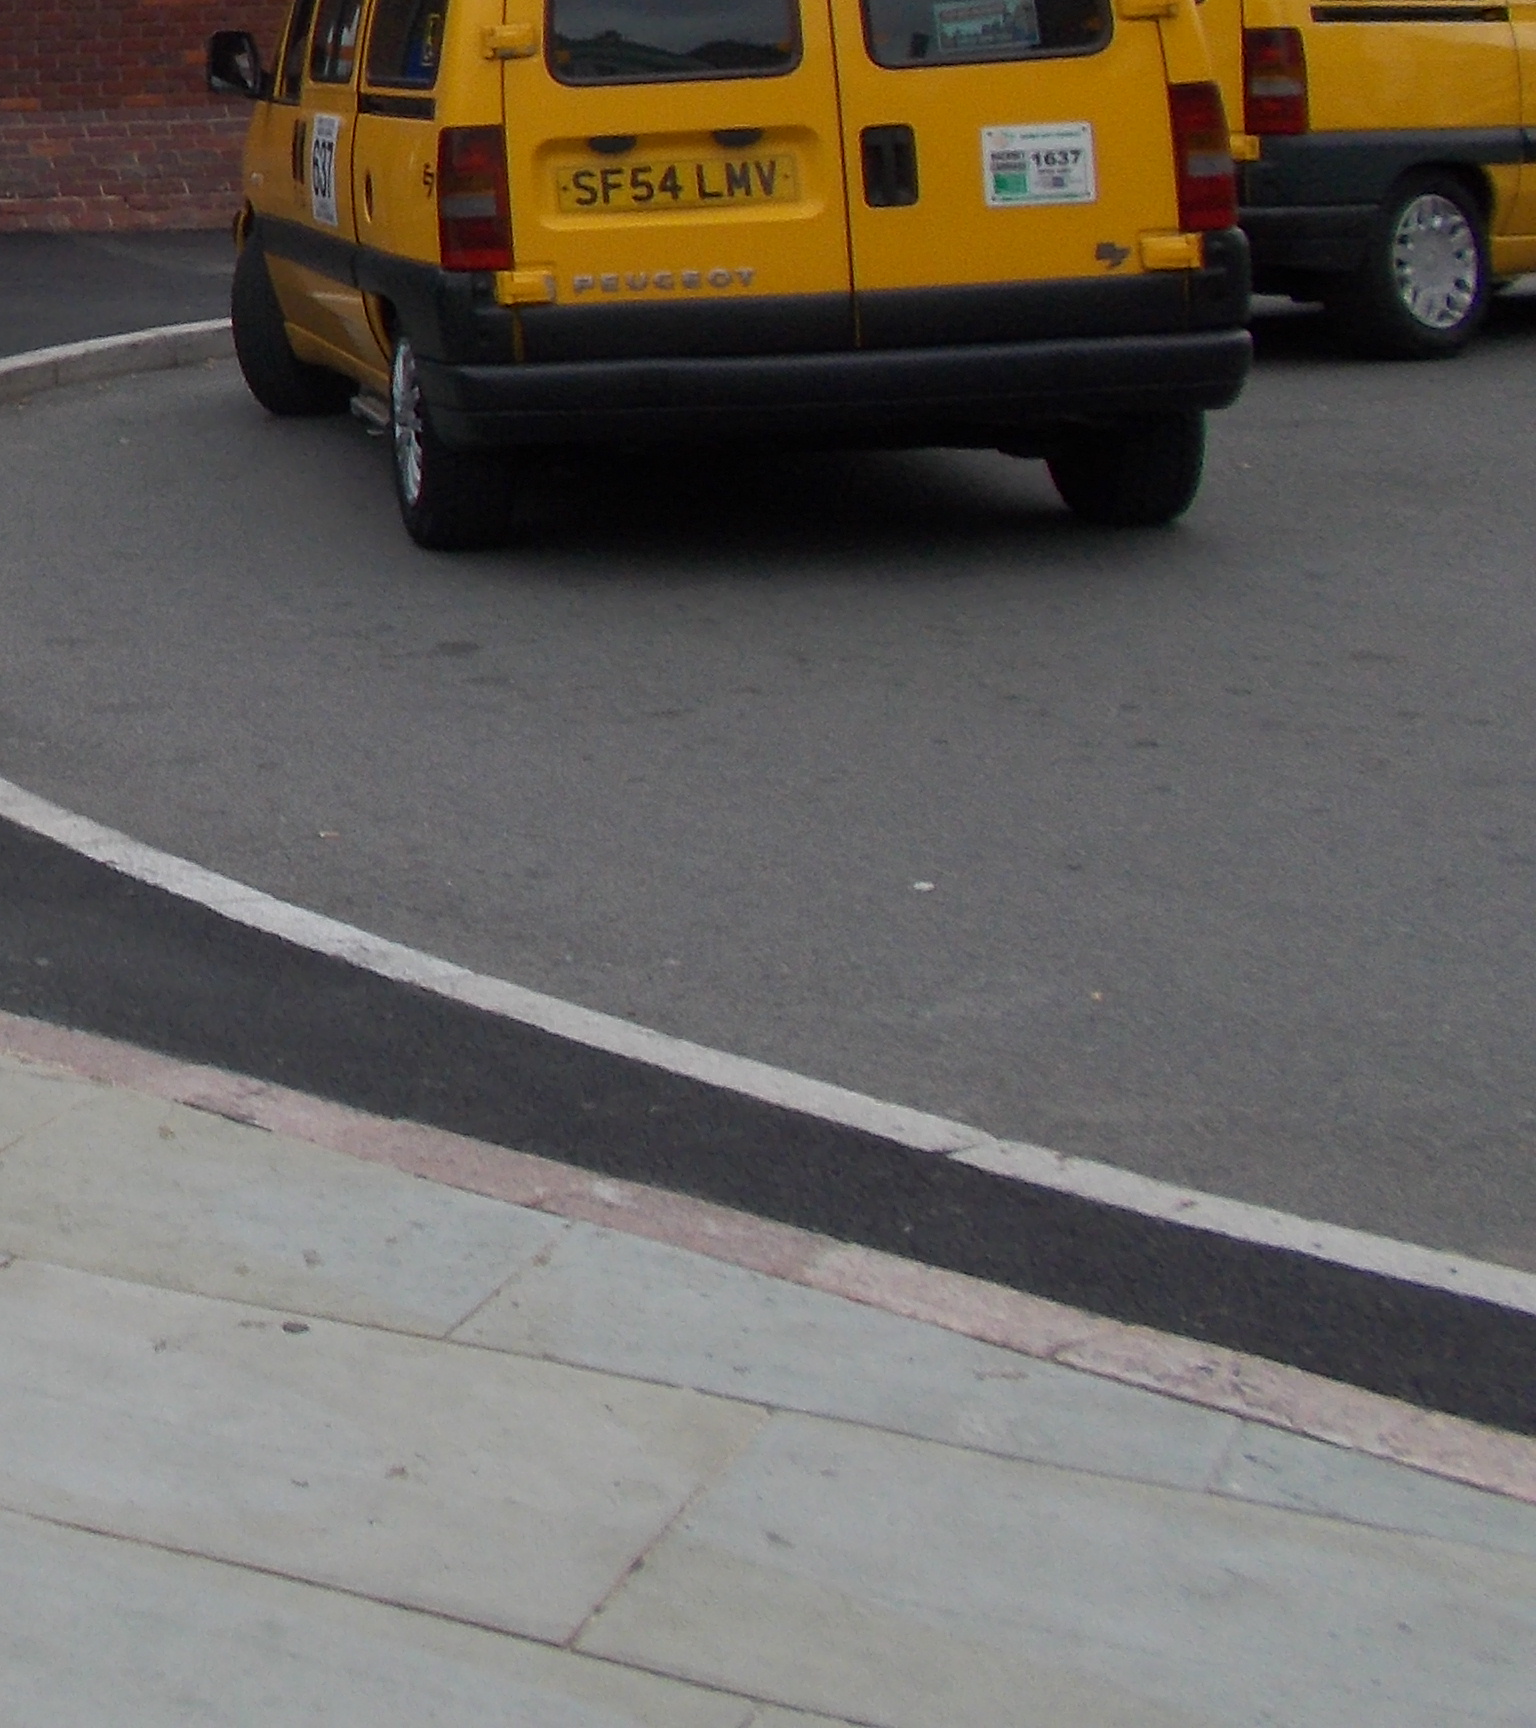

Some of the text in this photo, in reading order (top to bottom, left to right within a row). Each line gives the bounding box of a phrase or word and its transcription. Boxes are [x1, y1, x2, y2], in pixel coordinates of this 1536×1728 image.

[1030, 149, 1081, 168] 1637
[572, 160, 777, 206] SF54 LMV
[573, 268, 757, 294] PEUGEOT
